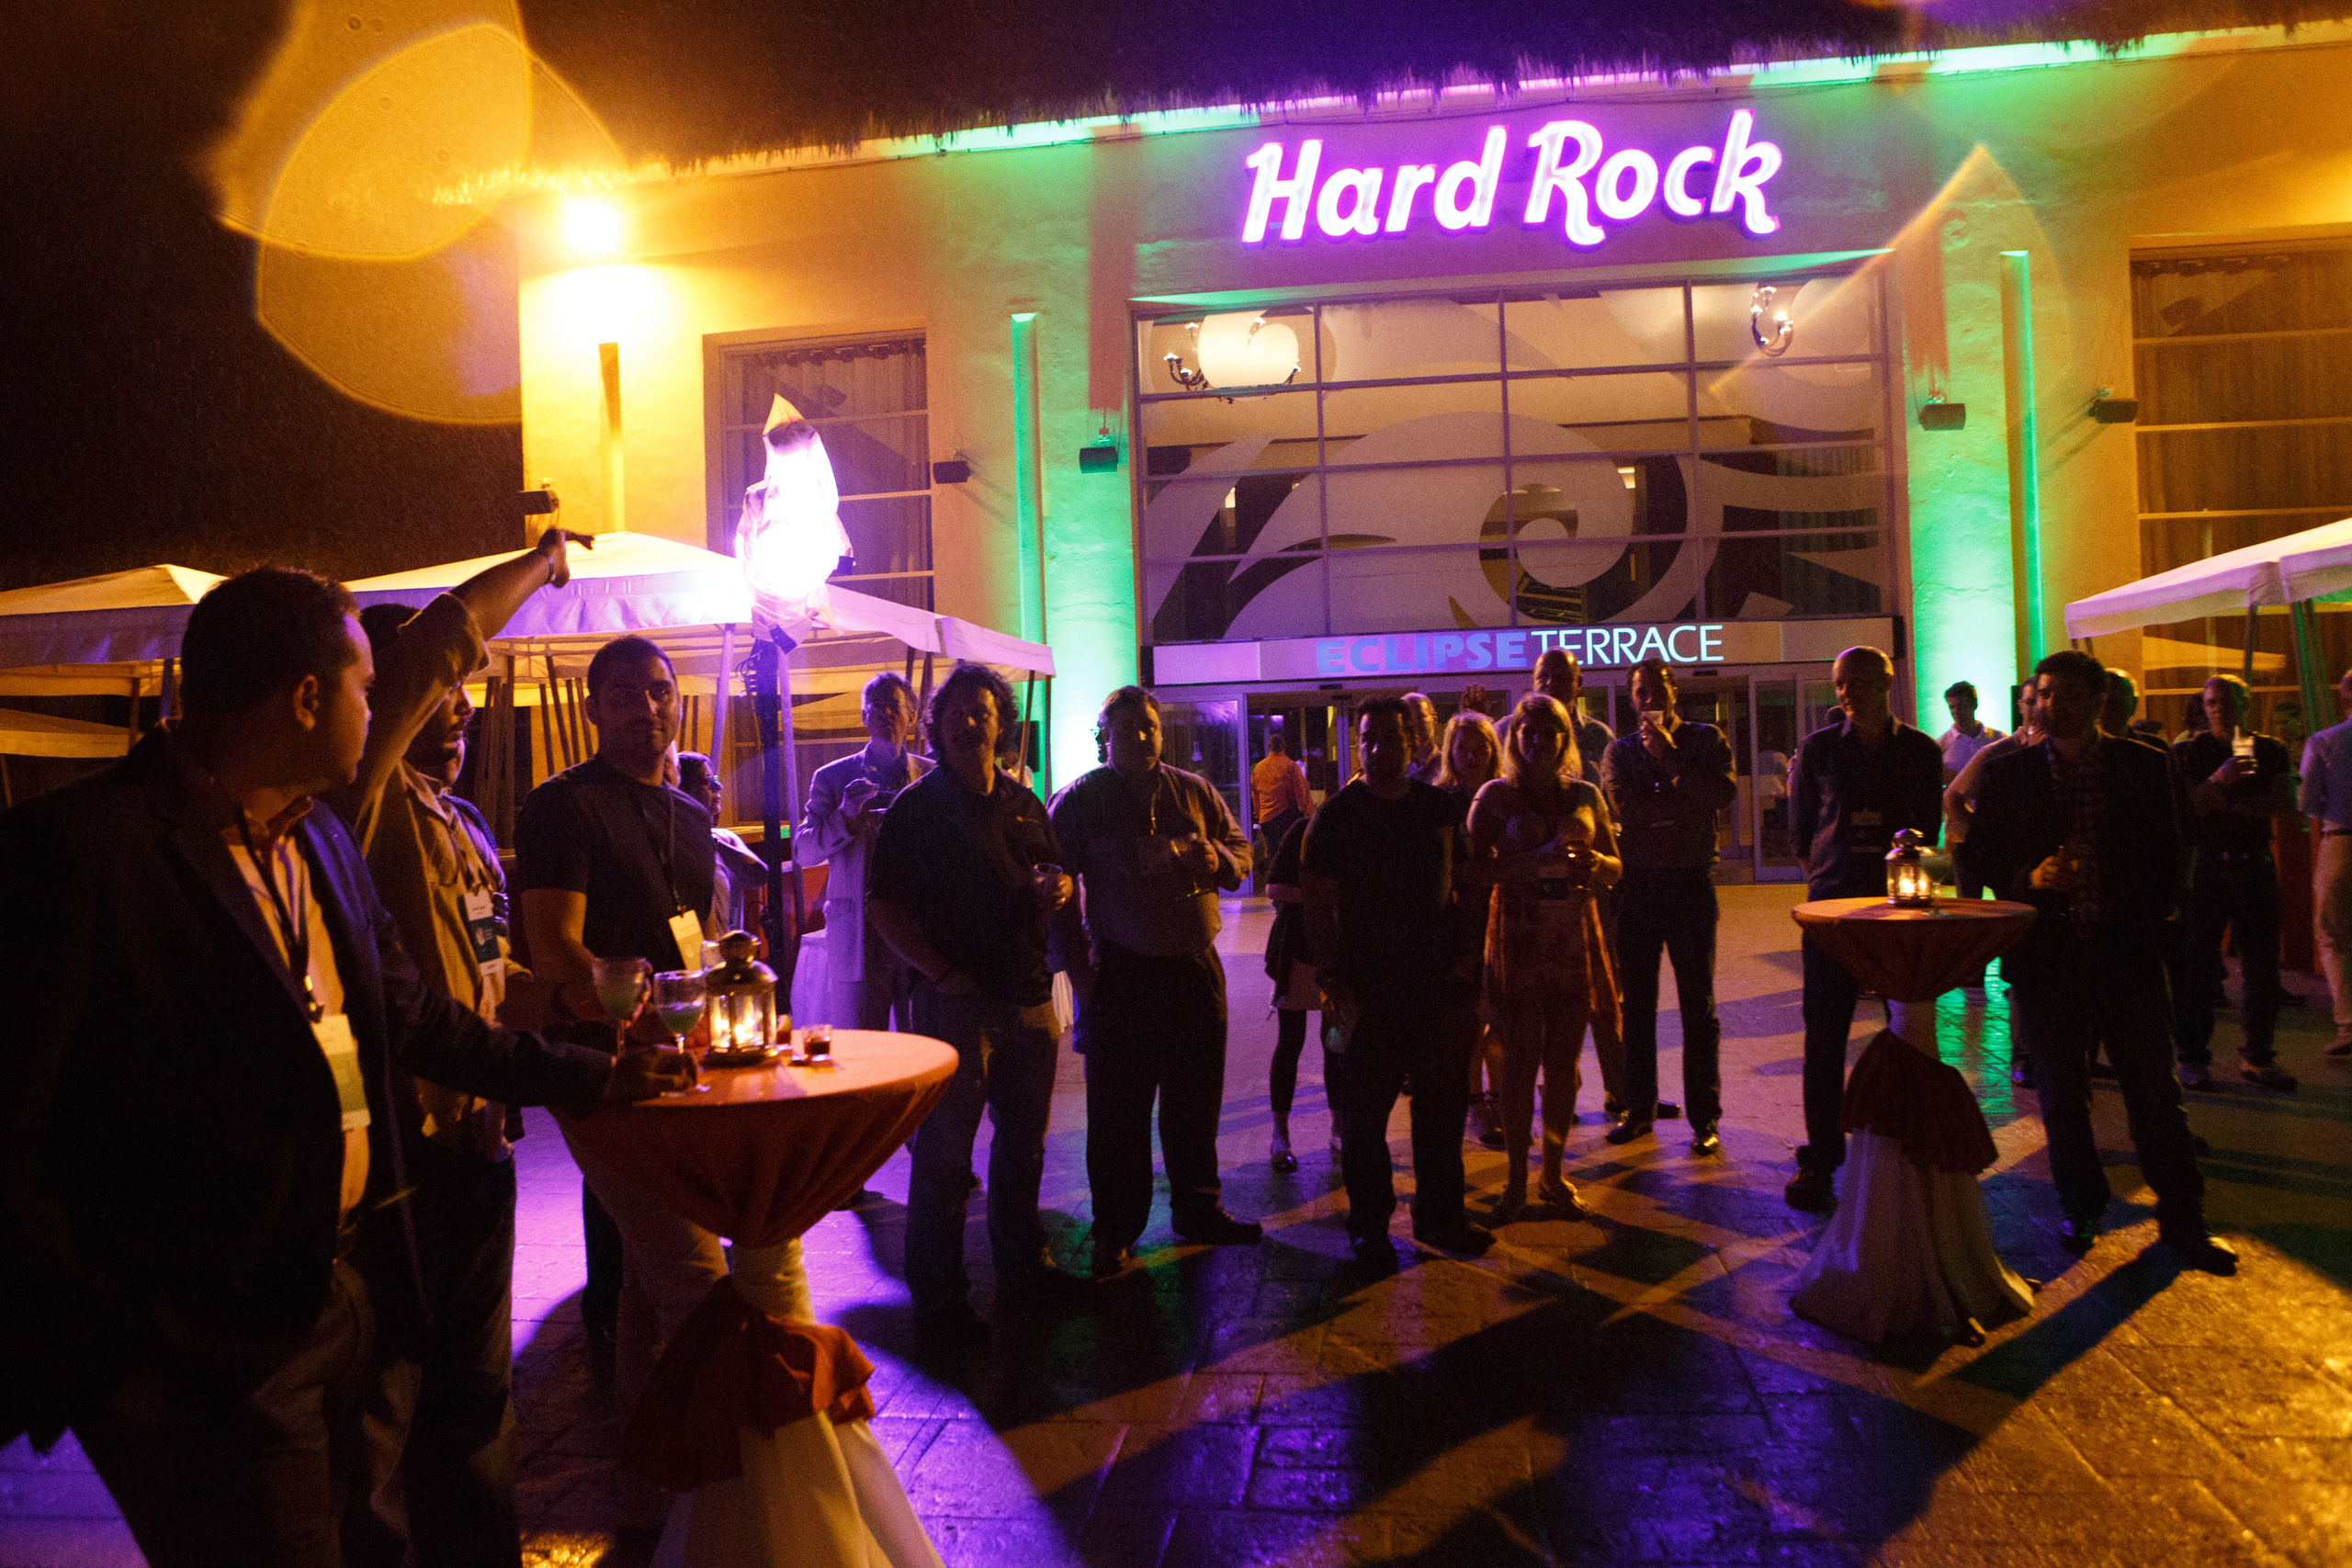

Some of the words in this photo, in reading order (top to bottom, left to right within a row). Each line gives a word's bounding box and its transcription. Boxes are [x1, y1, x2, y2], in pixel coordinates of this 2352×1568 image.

[1241, 125, 1508, 243] Hard
[1524, 108, 1782, 246] Rock
[1316, 631, 1527, 675] ECLIPSE
[1531, 625, 1724, 665] TERRACE
